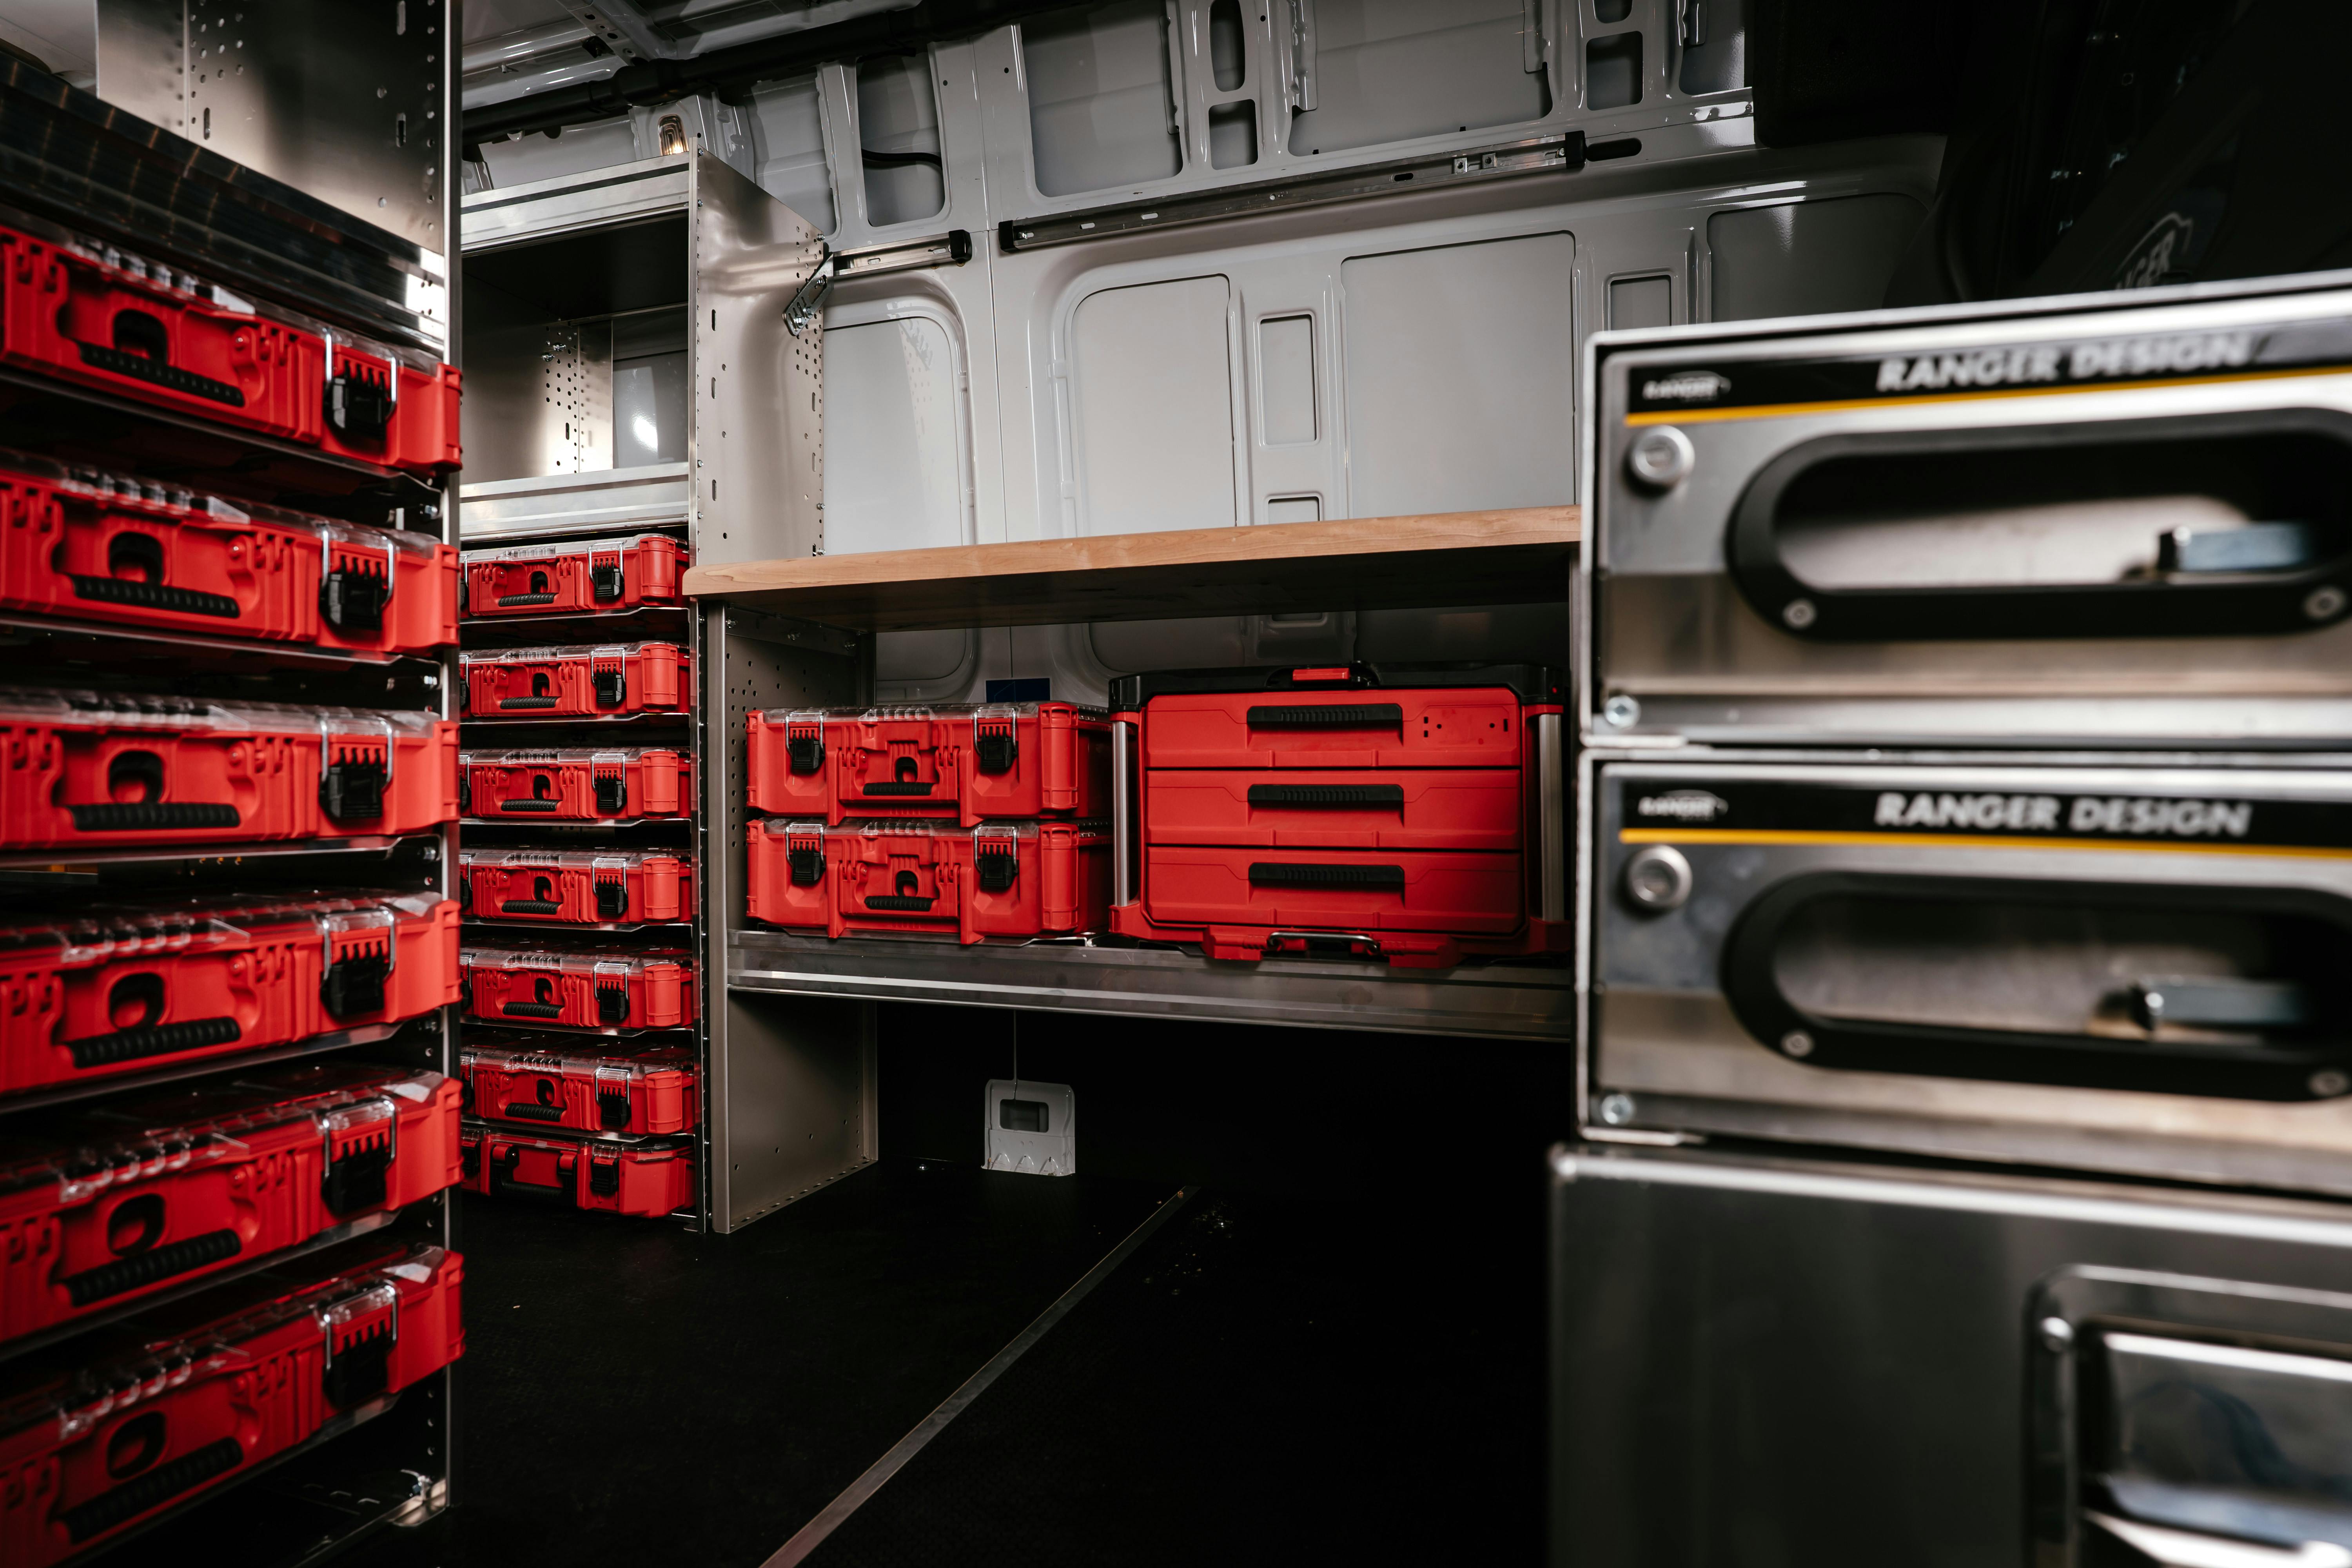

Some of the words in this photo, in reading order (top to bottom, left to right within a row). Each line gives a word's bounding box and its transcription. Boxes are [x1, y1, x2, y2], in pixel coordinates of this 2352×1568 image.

[1876, 349, 2060, 392] RANGER
[2068, 333, 2252, 379] DESIGN
[1875, 792, 2060, 831] RANGER
[2068, 797, 2253, 838] DESIGN
